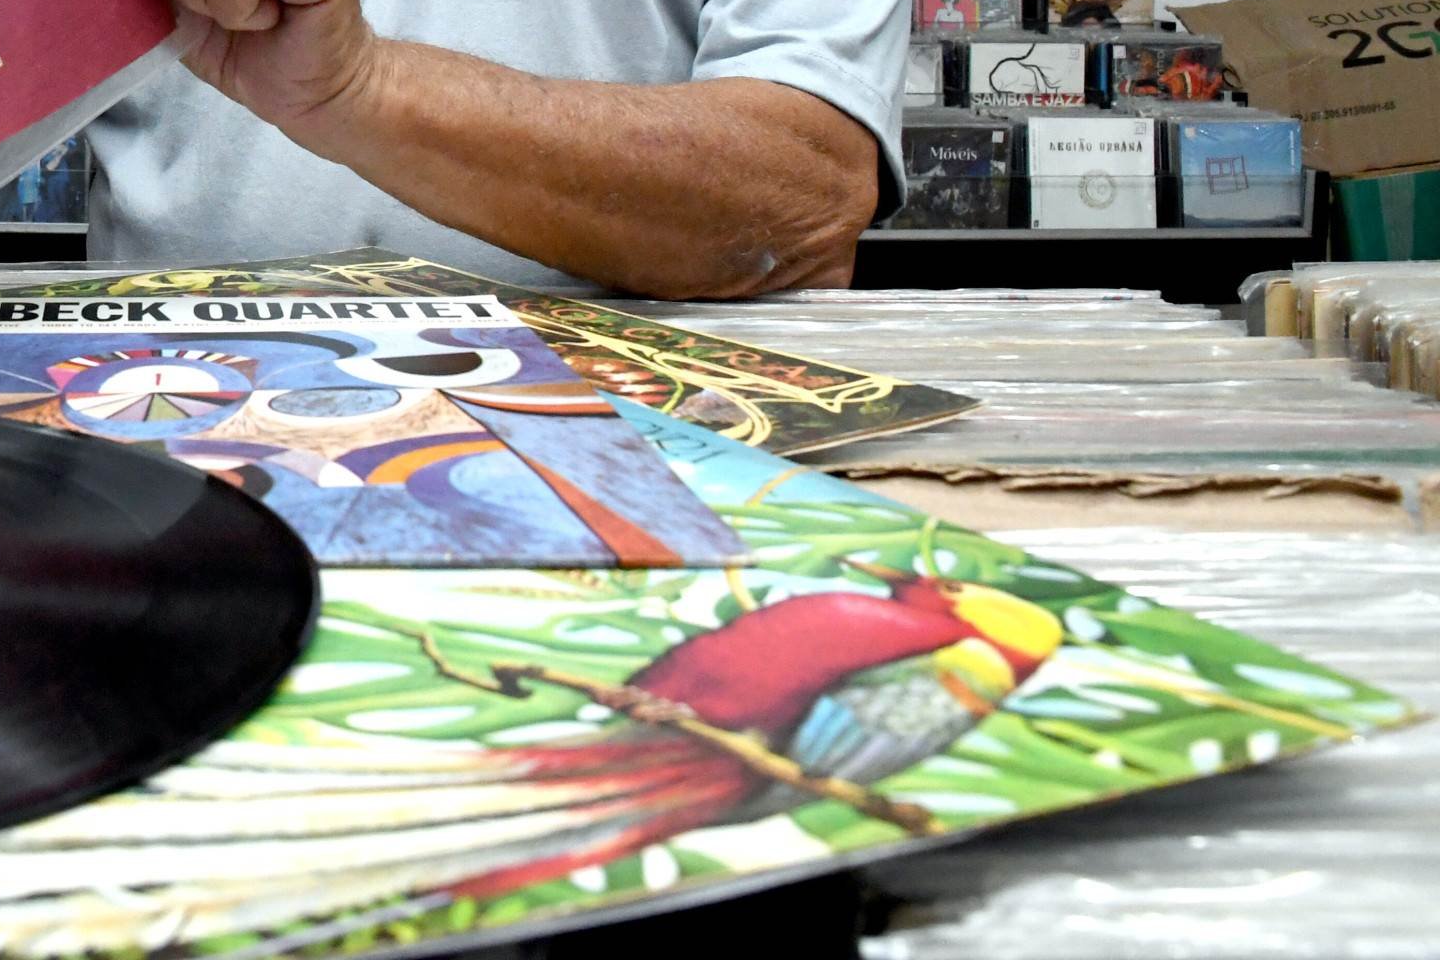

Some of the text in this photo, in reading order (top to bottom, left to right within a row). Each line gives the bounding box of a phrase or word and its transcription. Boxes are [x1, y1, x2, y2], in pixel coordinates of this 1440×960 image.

[971, 92, 1086, 107] SAMBA E JAZZ
[929, 145, 978, 161] Móveis
[193, 302, 493, 323] QUARTET
